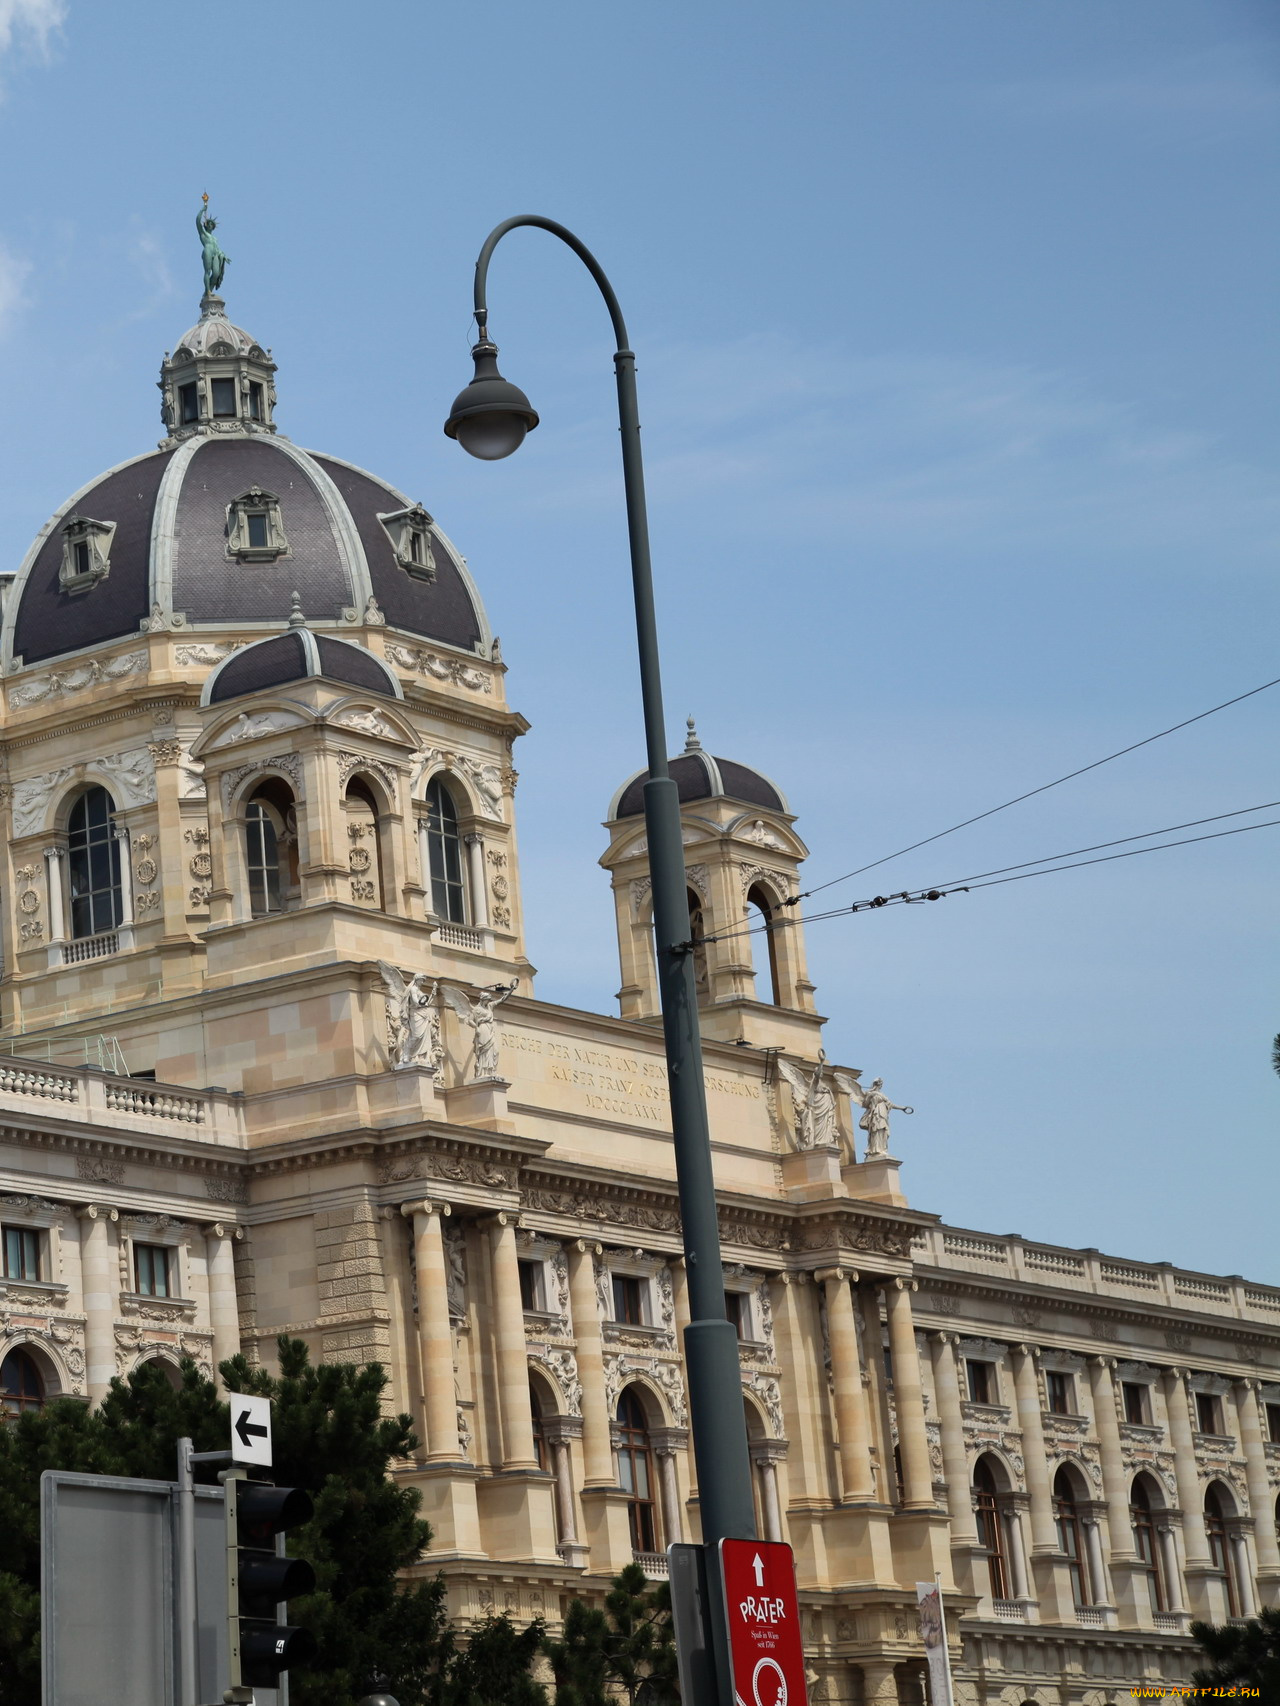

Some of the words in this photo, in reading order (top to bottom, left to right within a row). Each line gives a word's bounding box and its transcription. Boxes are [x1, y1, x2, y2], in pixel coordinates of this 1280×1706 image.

[500, 1032, 542, 1054] REICHE
[547, 1042, 571, 1060] DER
[574, 1048, 613, 1069] NATUR
[615, 1056, 639, 1074] UND
[551, 1065, 595, 1087] KAISER
[598, 1075, 633, 1095] FRANZ
[740, 1595, 786, 1624] PRATER
[275, 1640, 283, 1653] 4
[768, 1631, 780, 1640] Wien
